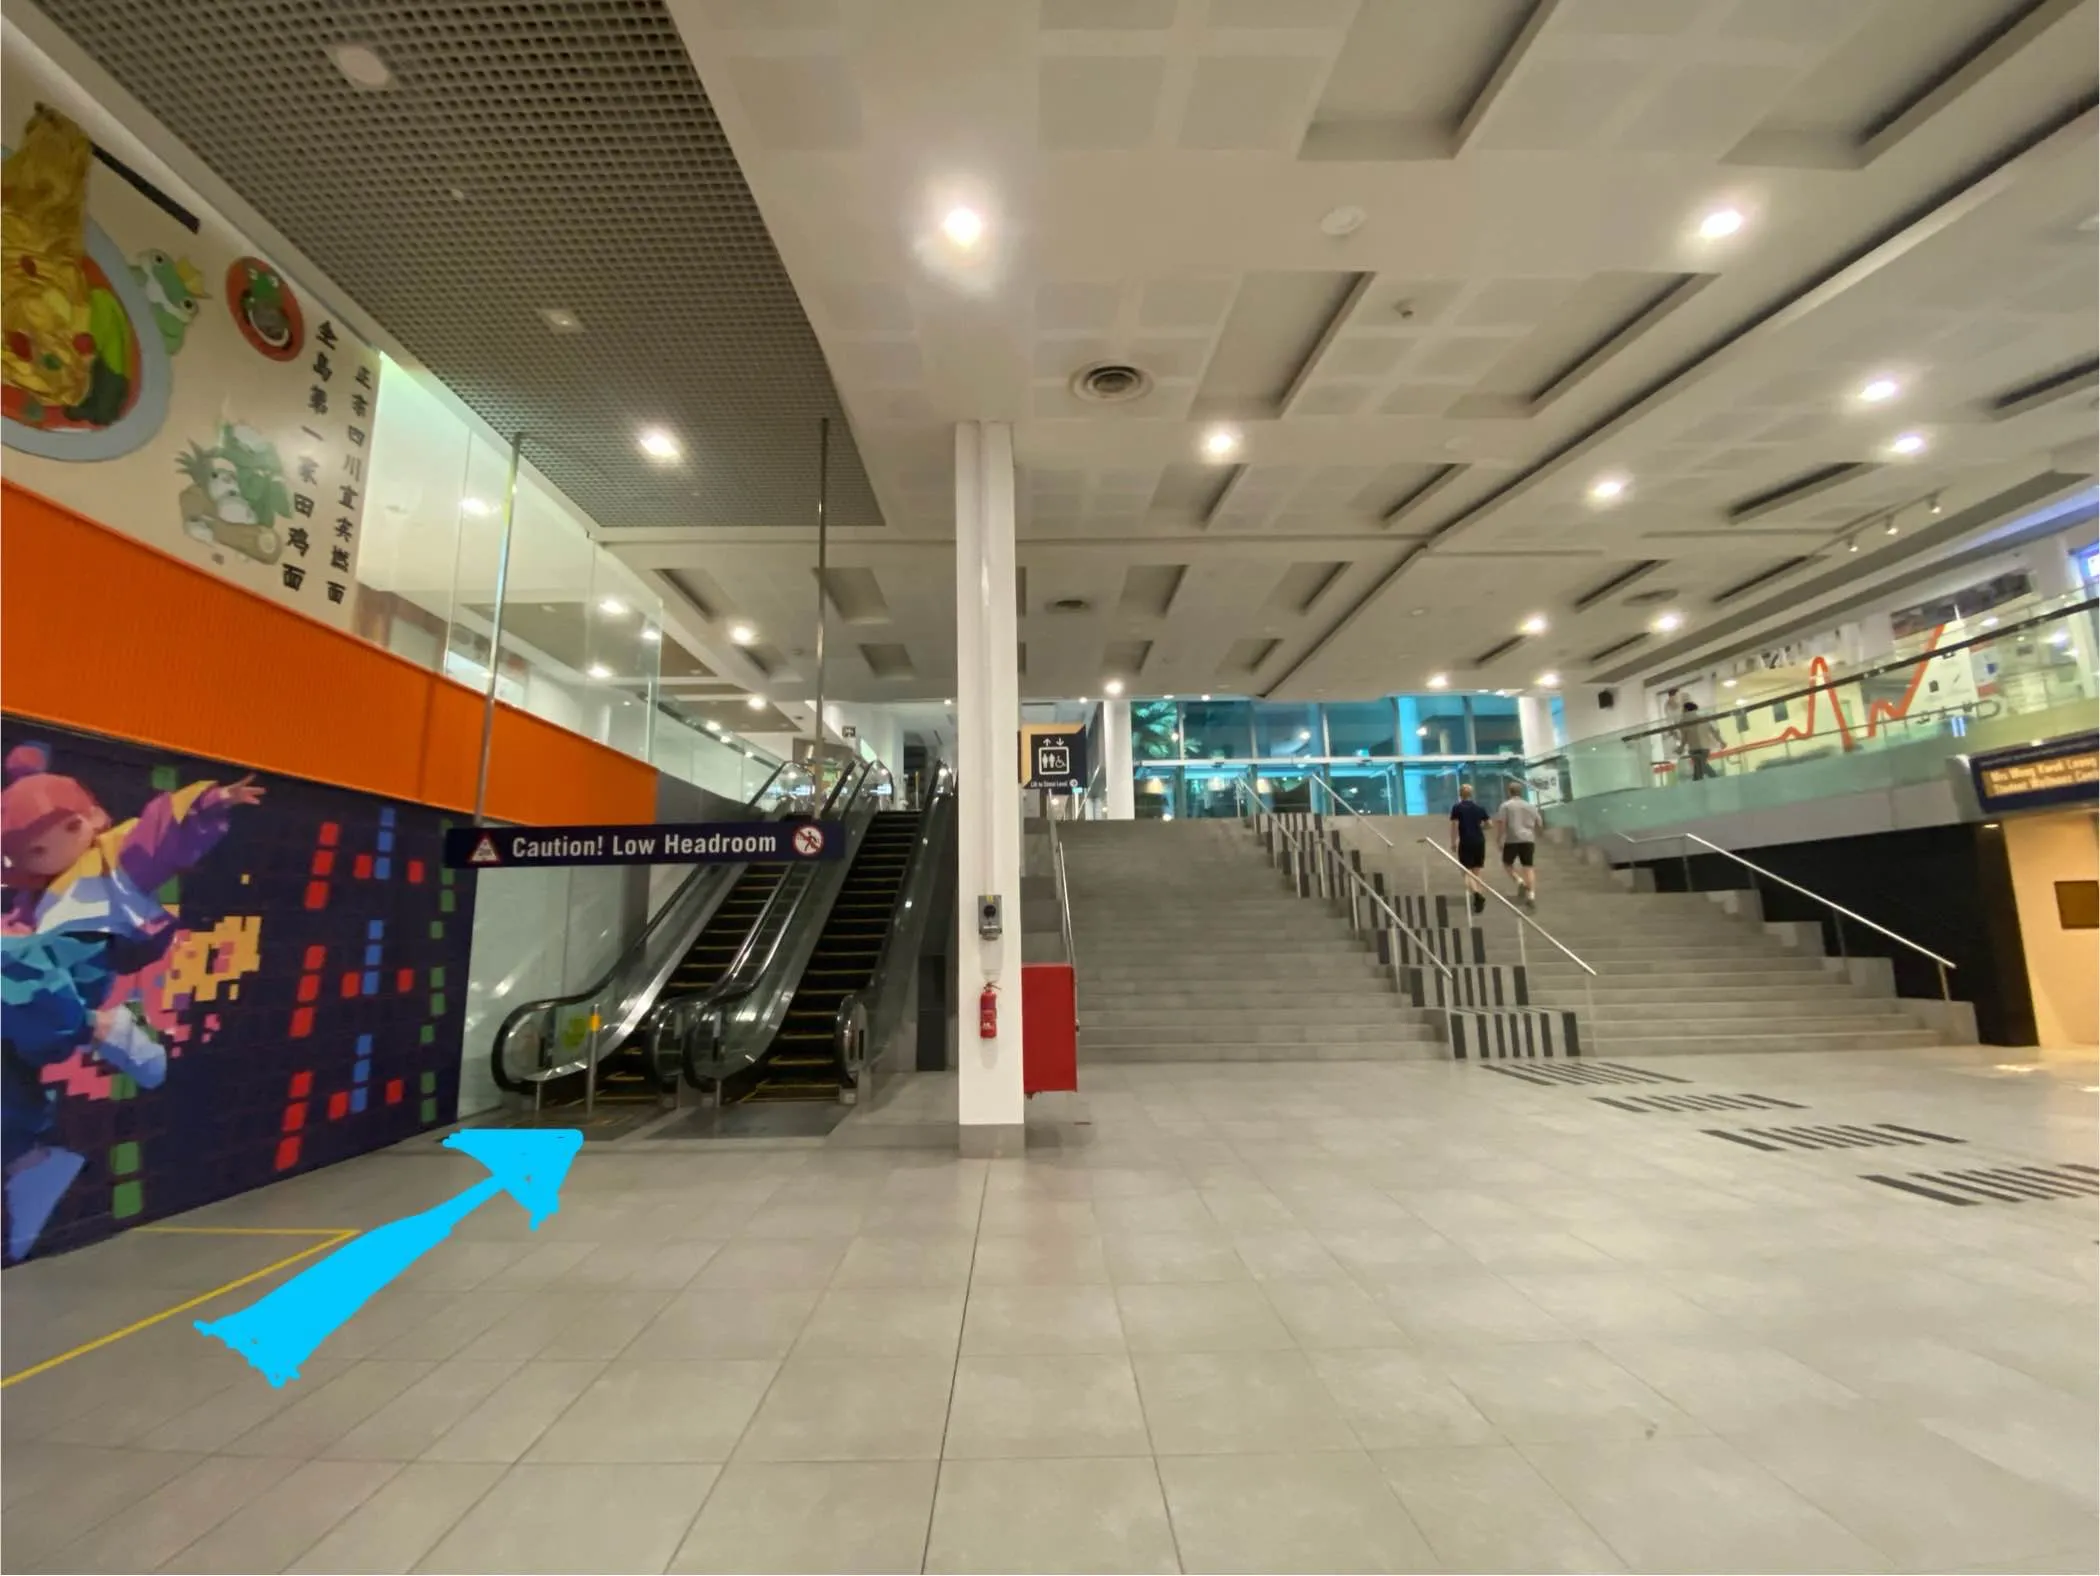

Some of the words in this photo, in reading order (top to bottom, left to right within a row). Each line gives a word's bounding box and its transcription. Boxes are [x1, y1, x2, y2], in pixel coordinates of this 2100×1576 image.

[511, 836, 604, 858] Caution!
[611, 834, 656, 856] Low
[663, 833, 777, 854] Headroom
